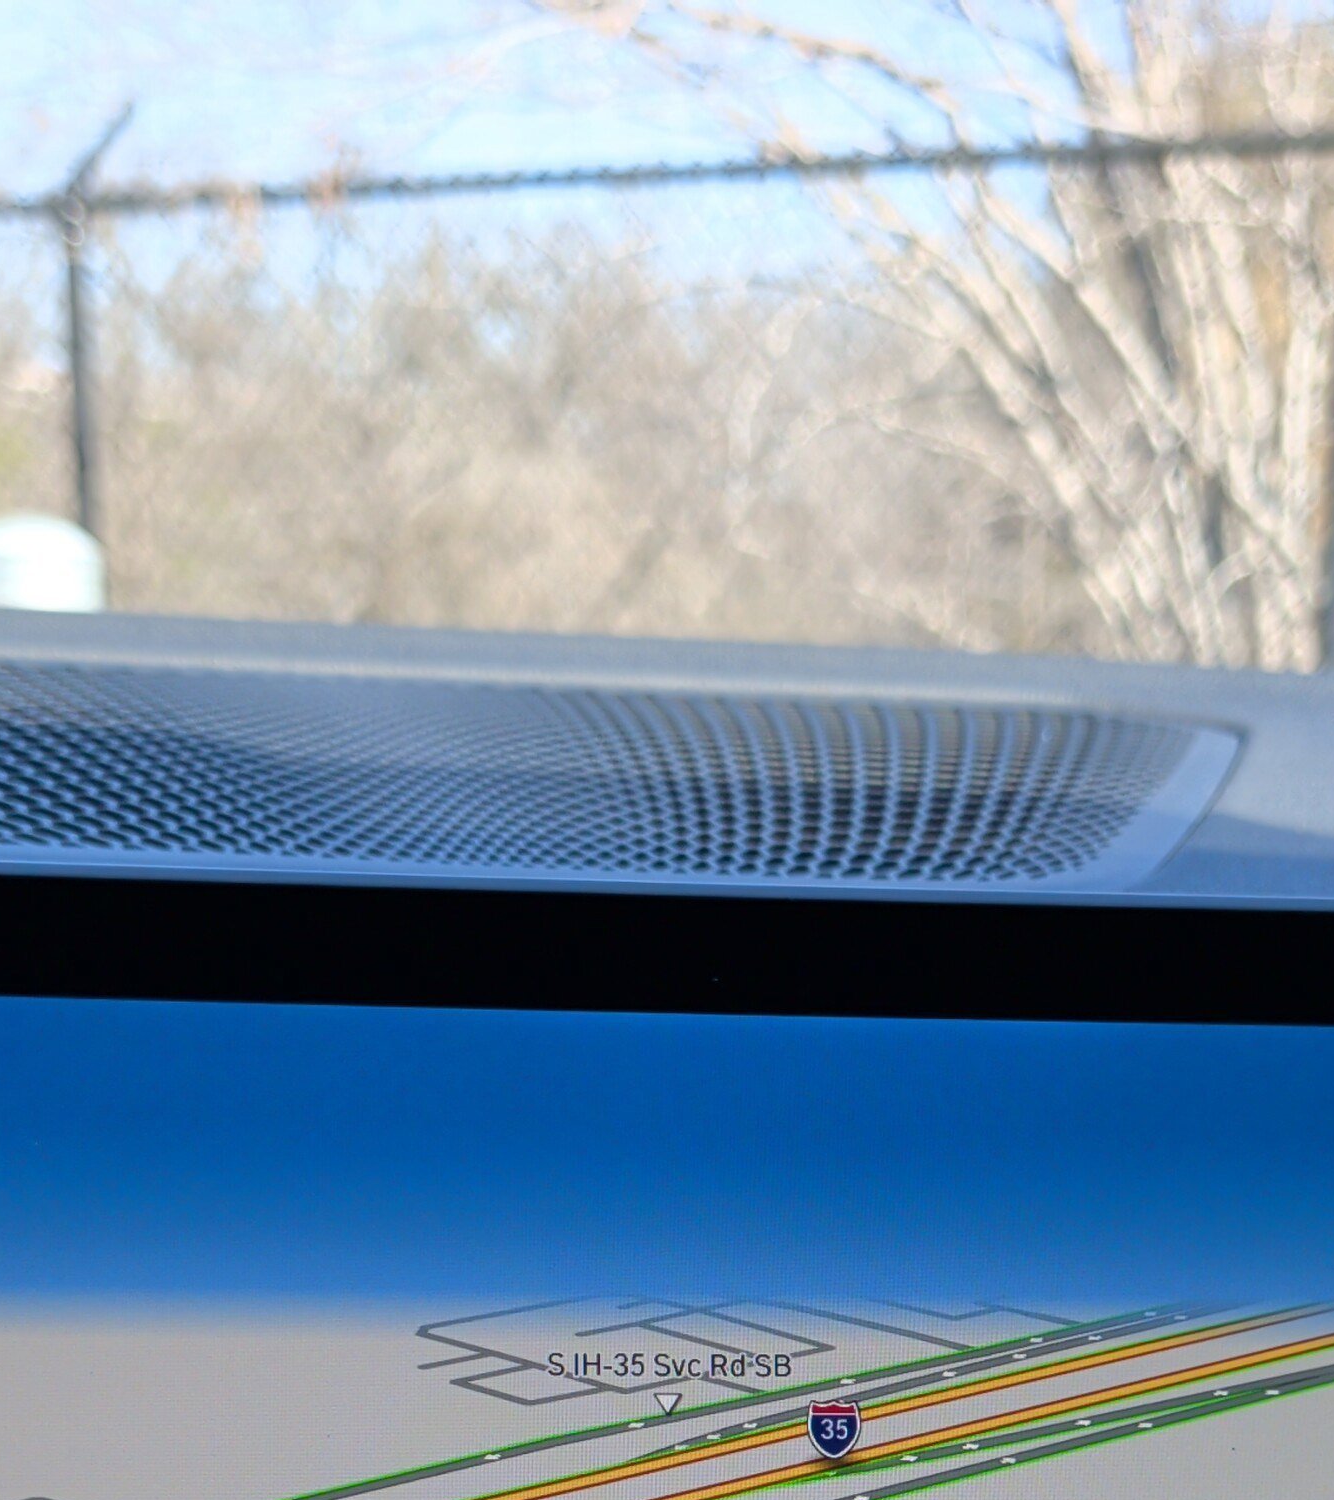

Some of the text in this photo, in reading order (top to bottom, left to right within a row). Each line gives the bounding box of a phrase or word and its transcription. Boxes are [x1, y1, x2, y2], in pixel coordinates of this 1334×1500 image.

[548, 1353, 792, 1378] S IH-35 Svc Rd SB
[820, 1418, 848, 1441] 35
